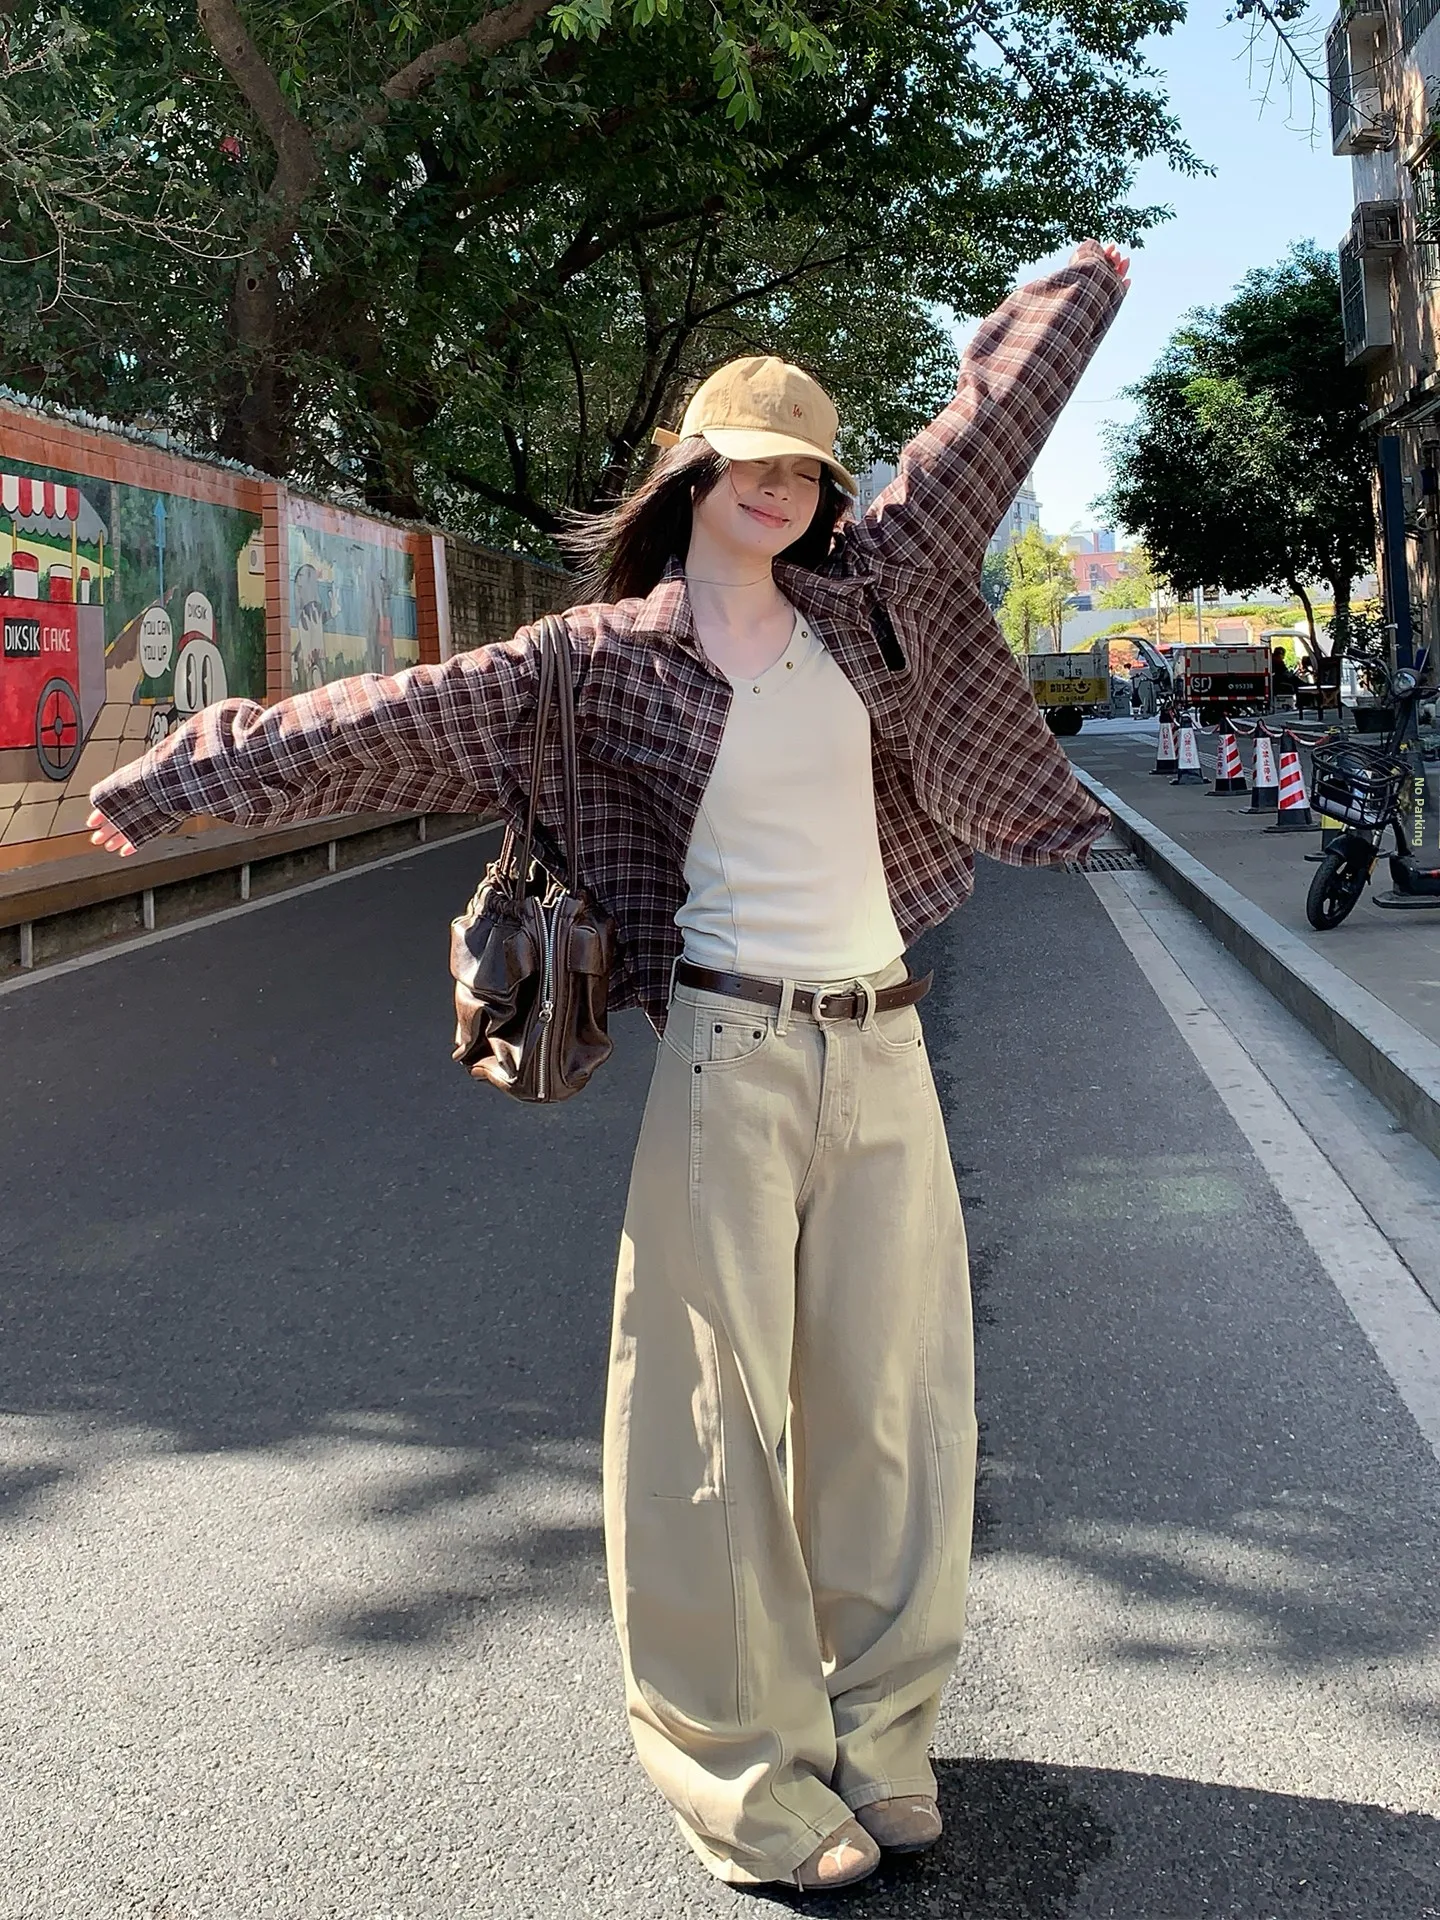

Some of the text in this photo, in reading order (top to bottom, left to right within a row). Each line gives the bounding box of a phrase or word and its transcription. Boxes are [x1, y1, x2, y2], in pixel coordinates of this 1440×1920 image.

[4, 625, 71, 652] DIKSIK CAKE
[157, 644, 168, 661] UP
[1411, 778, 1426, 847] No Parking
